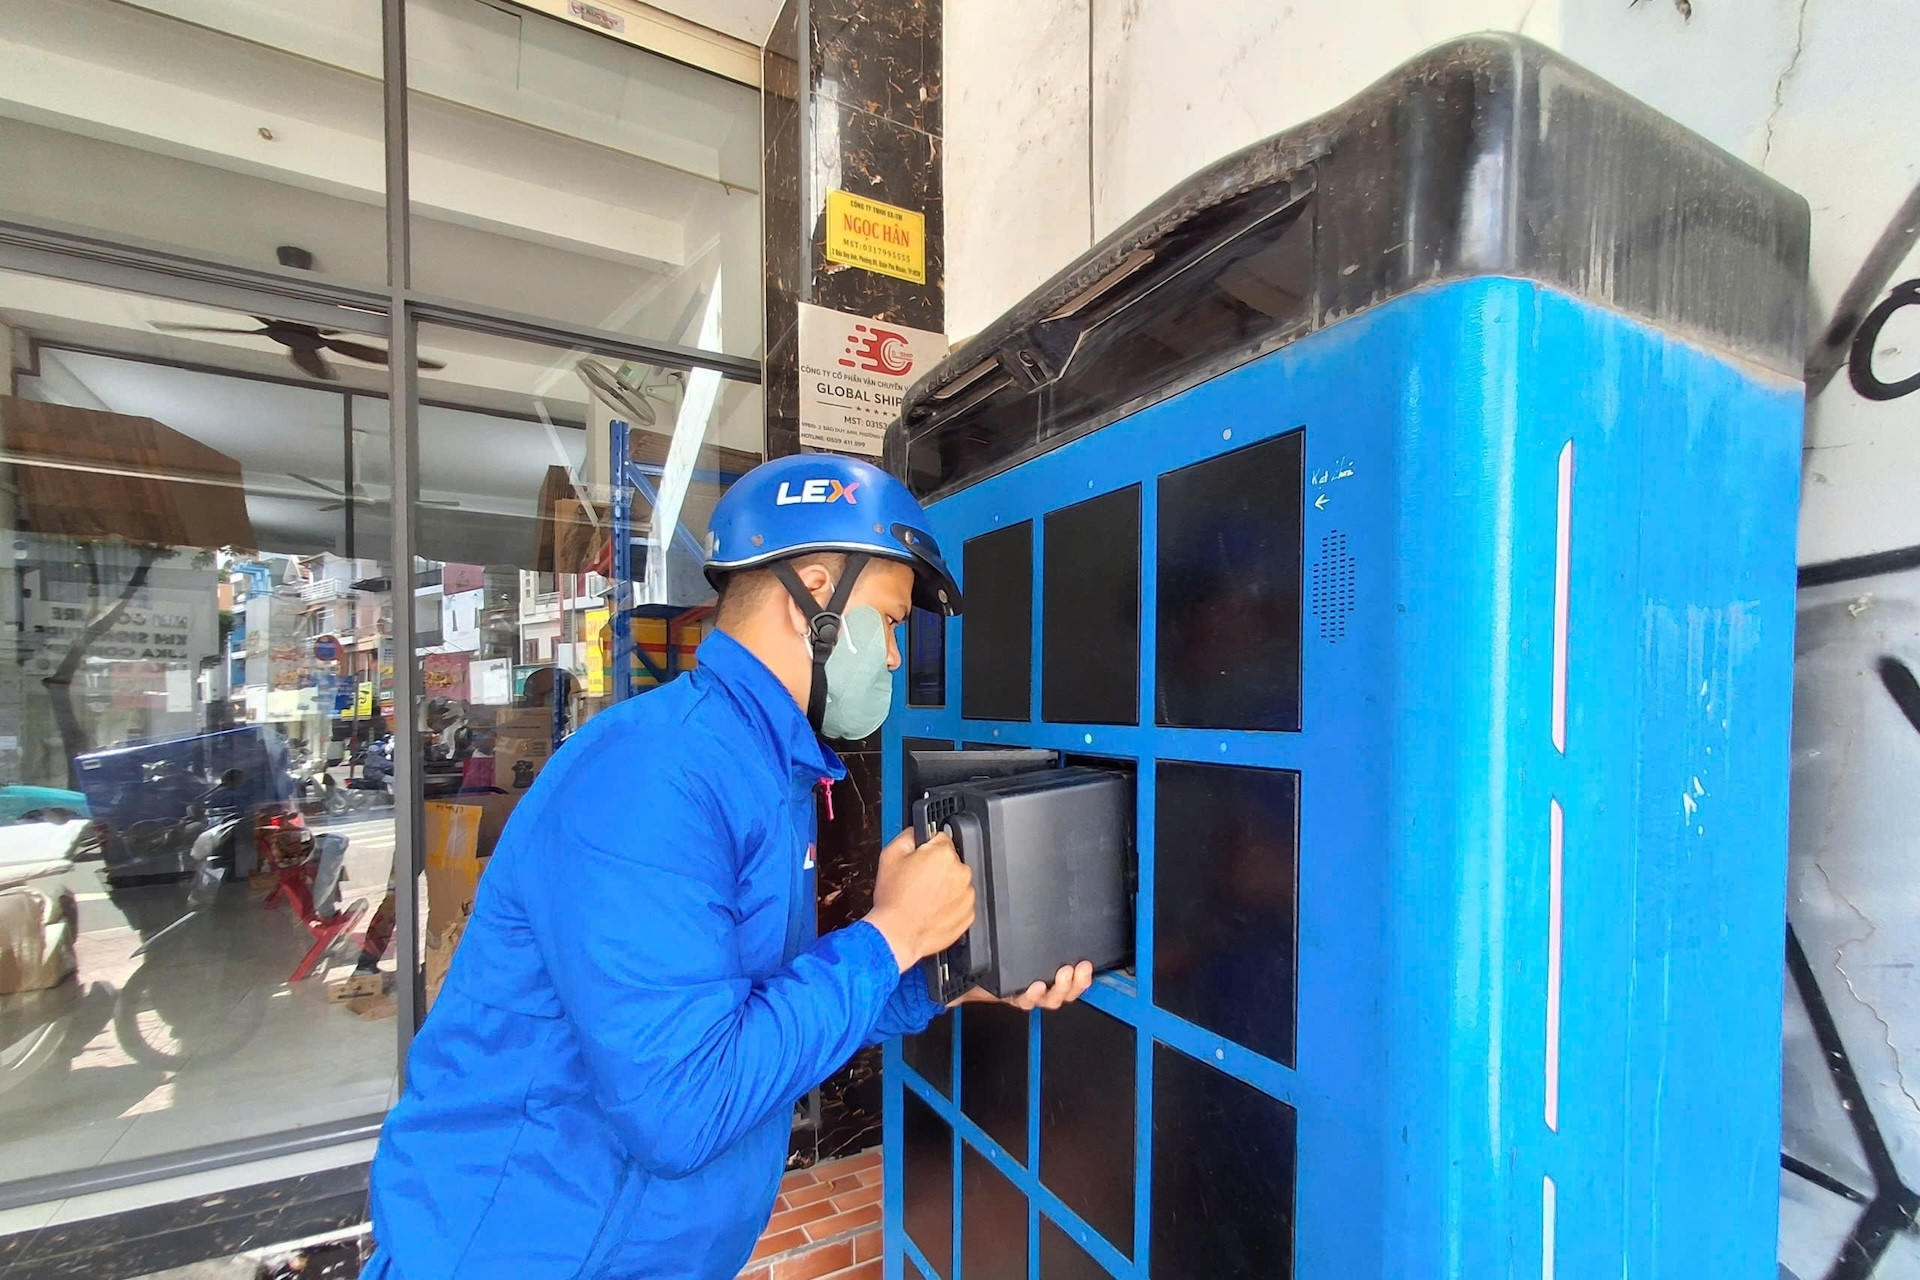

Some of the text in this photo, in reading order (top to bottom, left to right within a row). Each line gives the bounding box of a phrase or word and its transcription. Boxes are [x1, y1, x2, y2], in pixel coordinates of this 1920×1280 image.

[843, 213, 910, 248] NGỌC HÂN
[800, 365, 821, 376] CÔNG
[816, 382, 902, 407] GLOBAL SHIP
[844, 416, 864, 426] MST:
[776, 479, 860, 505] LEX
